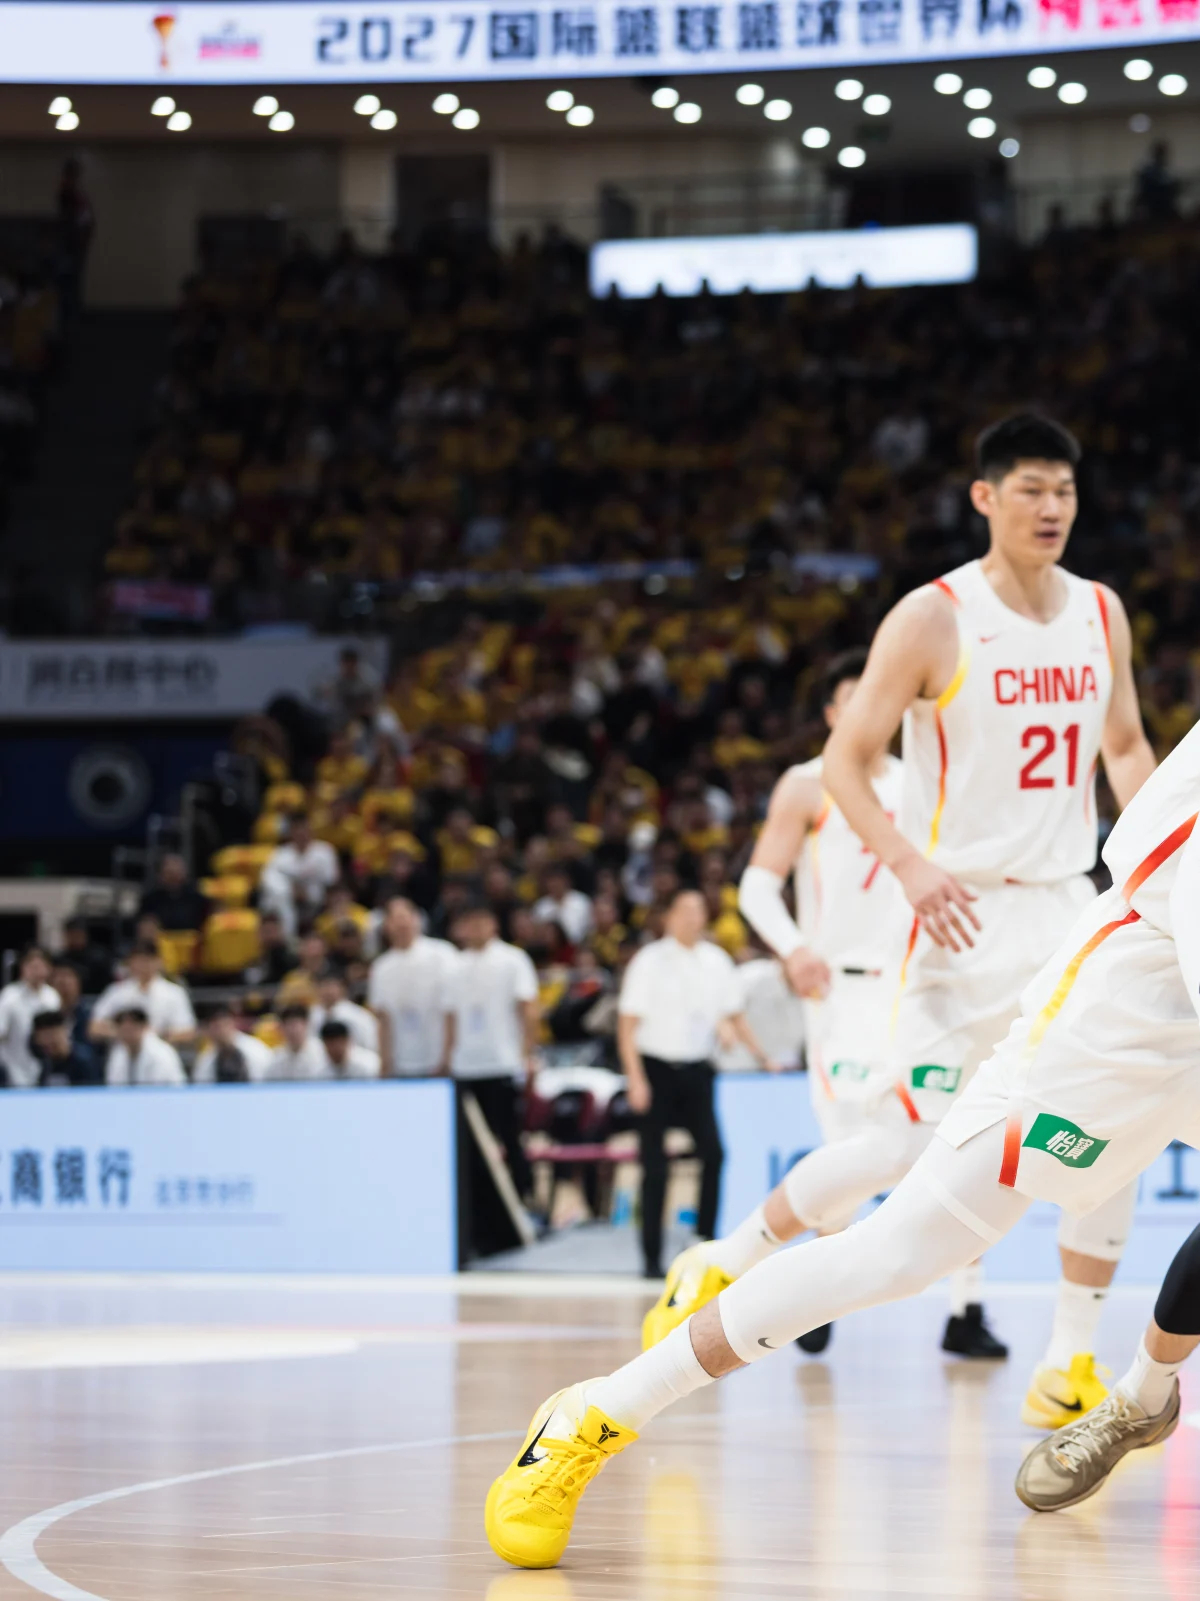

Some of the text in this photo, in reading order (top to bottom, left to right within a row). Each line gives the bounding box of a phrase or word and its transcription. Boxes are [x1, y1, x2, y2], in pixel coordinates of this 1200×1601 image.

[993, 664, 1099, 706] CHINA
[1018, 722, 1081, 790] 21
[0, 1145, 131, 1207] 商银行
